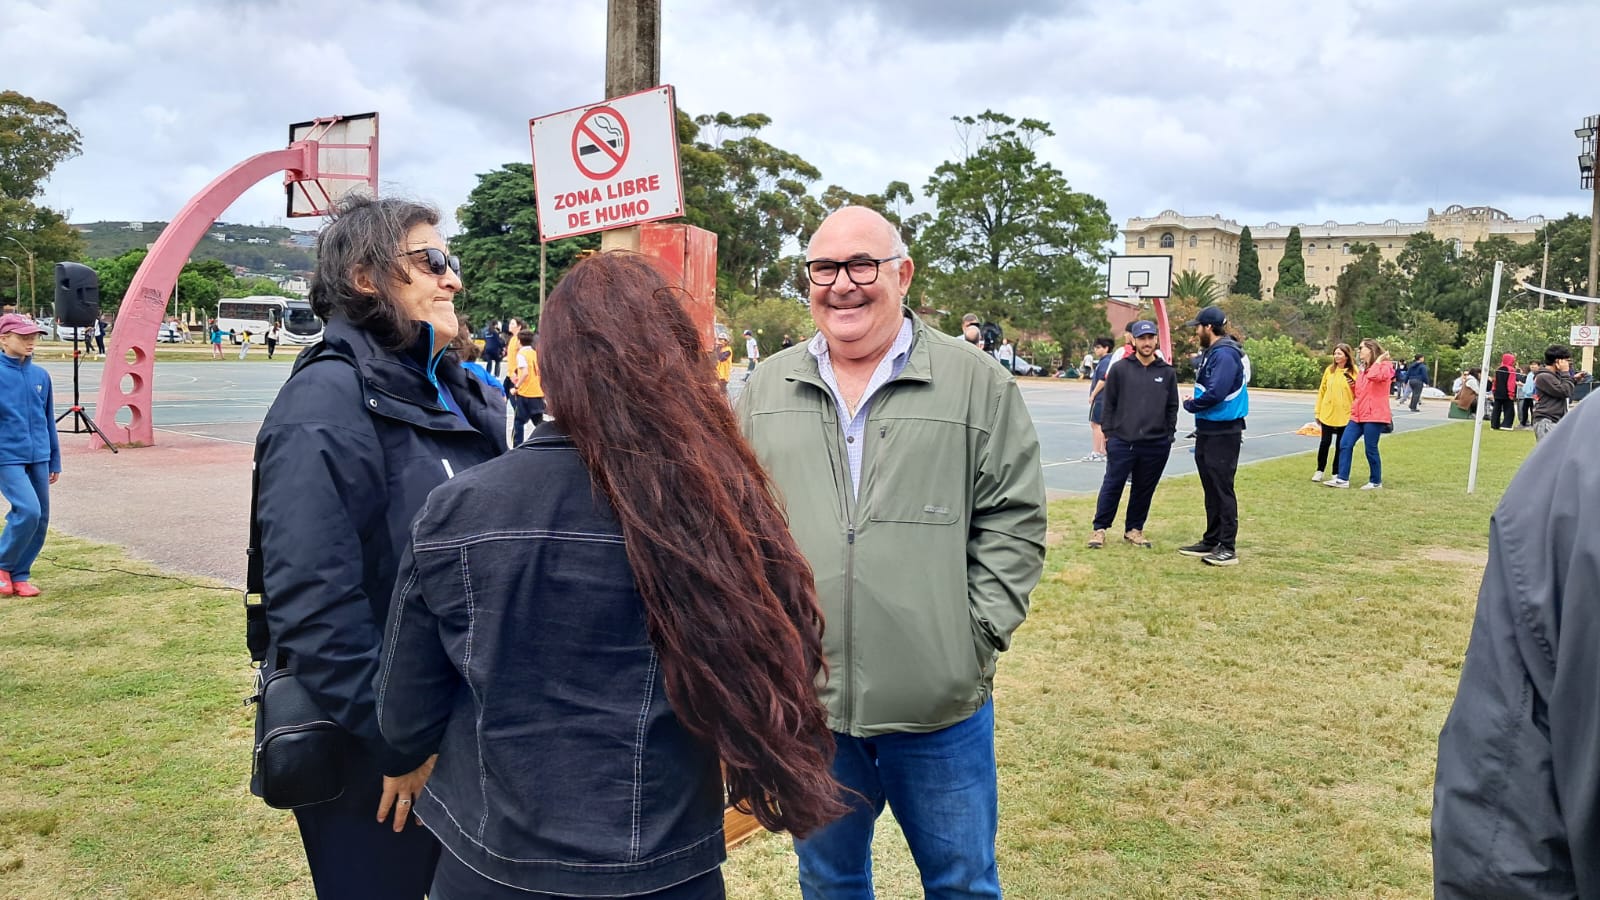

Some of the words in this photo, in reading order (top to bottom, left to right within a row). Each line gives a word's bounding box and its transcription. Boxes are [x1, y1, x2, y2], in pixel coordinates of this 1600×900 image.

[554, 187, 602, 211] ZONA
[607, 174, 660, 200] LIBRE
[567, 210, 591, 229] DE
[595, 199, 650, 223] HUMO
